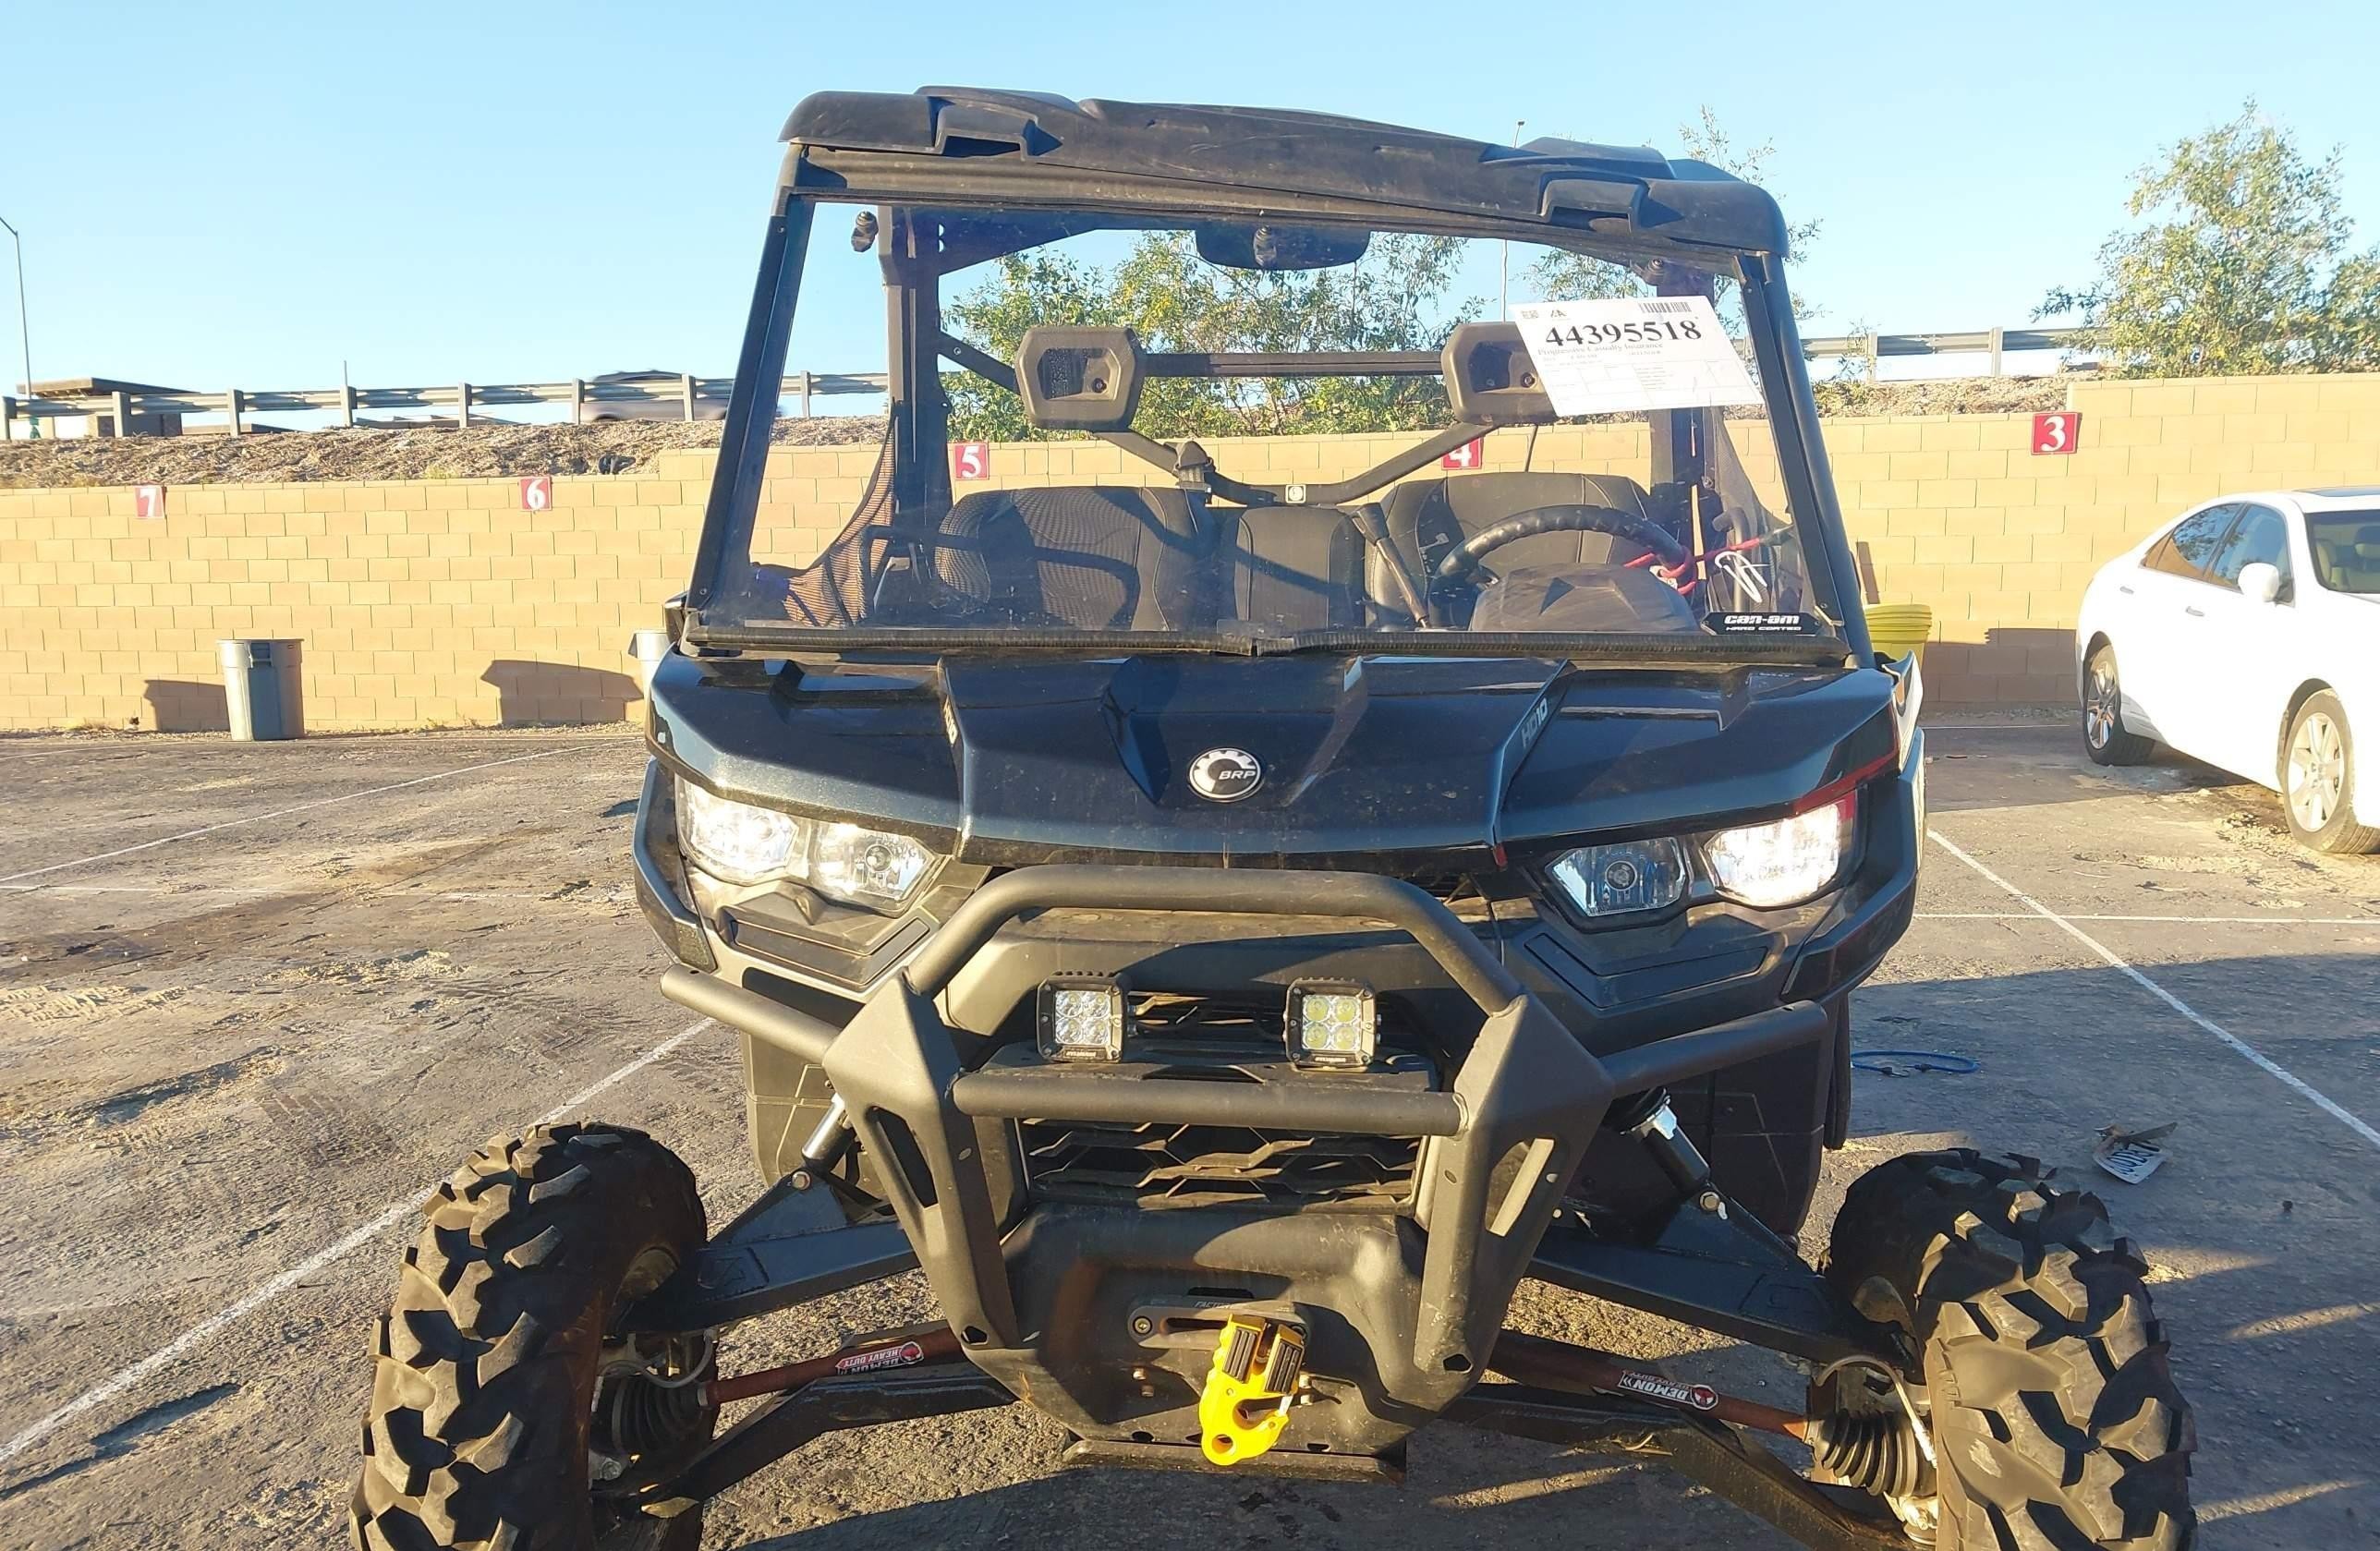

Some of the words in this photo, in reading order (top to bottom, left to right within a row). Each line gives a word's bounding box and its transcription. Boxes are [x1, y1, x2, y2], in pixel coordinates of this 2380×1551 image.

[1545, 320, 1702, 345] 44395518
[2041, 415, 2066, 452] 3
[961, 444, 981, 479] 5
[1448, 442, 1473, 467] 4
[140, 487, 157, 518] 7
[527, 479, 546, 510] 6
[1724, 614, 1800, 624] can-am
[1219, 770, 1257, 780] BRP
[844, 1356, 867, 1367] DUTY
[868, 1349, 898, 1363] HEAVY
[1633, 1379, 1690, 1400] DEMON
